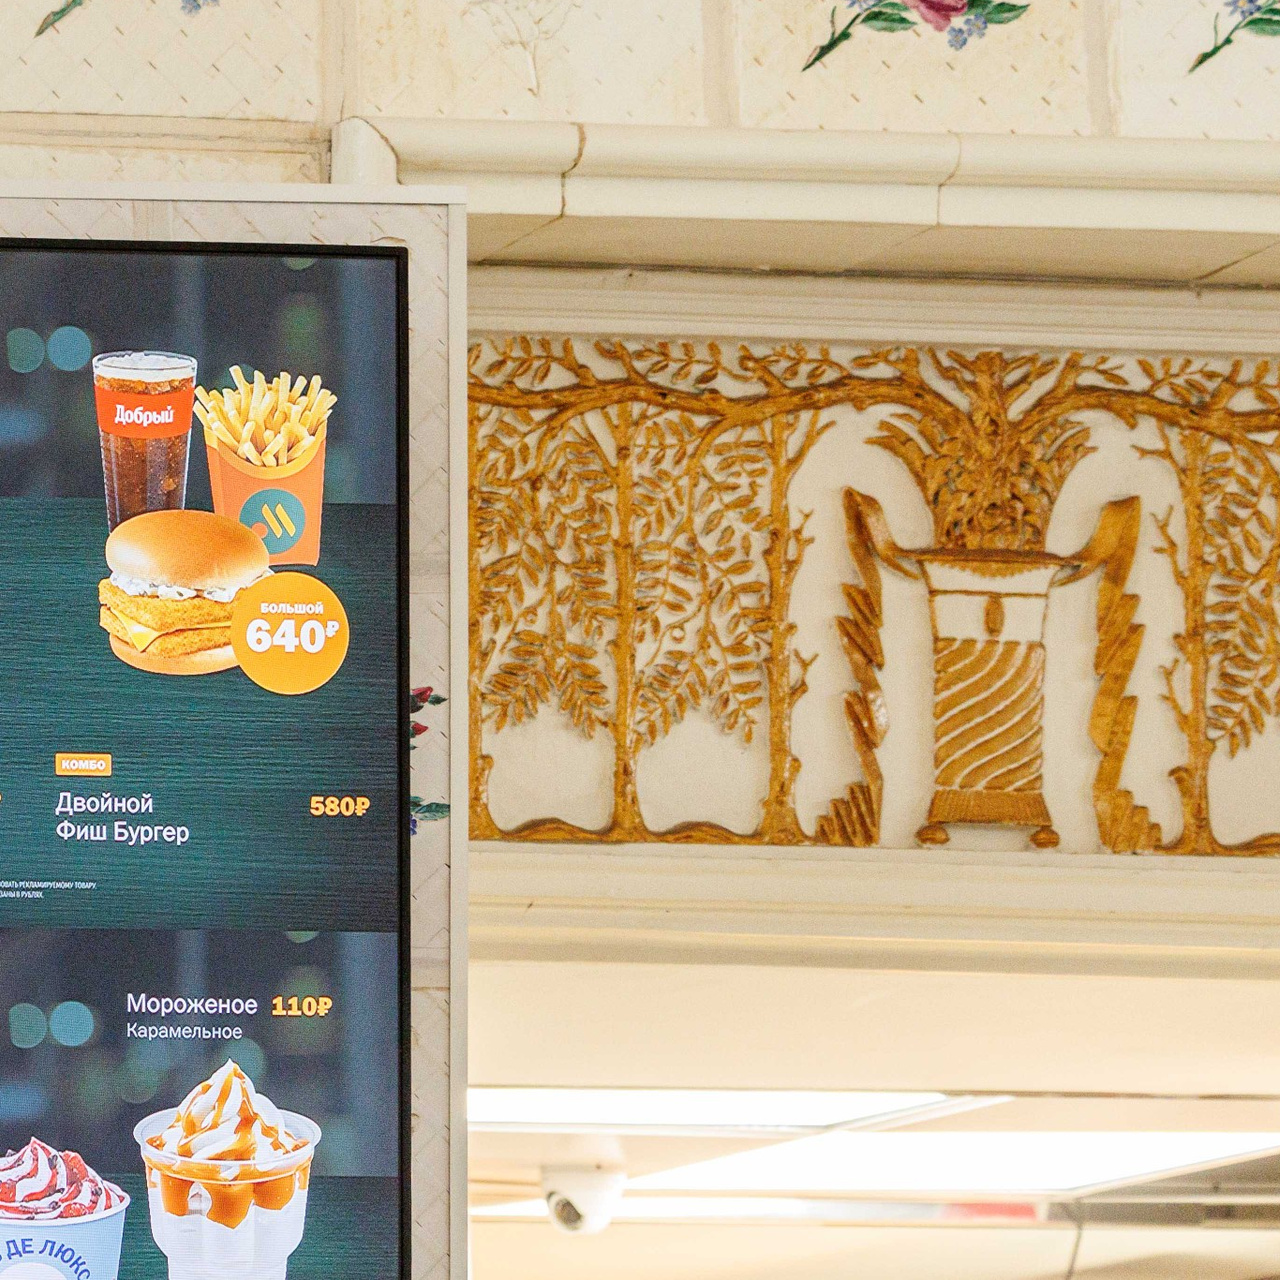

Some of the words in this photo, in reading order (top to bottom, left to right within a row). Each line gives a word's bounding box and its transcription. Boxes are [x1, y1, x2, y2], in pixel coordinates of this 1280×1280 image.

[114, 404, 175, 428] Добрый
[261, 602, 324, 615] БОЛЬШОЙ
[61, 759, 106, 771] КОМБО
[55, 792, 153, 816] Двойной
[56, 821, 107, 841] Фиш
[113, 821, 189, 846] Бургер
[127, 993, 258, 1016] Мороженое
[127, 1023, 243, 1041] Карамельное
[5, 1238, 34, 1259] ДЕ
